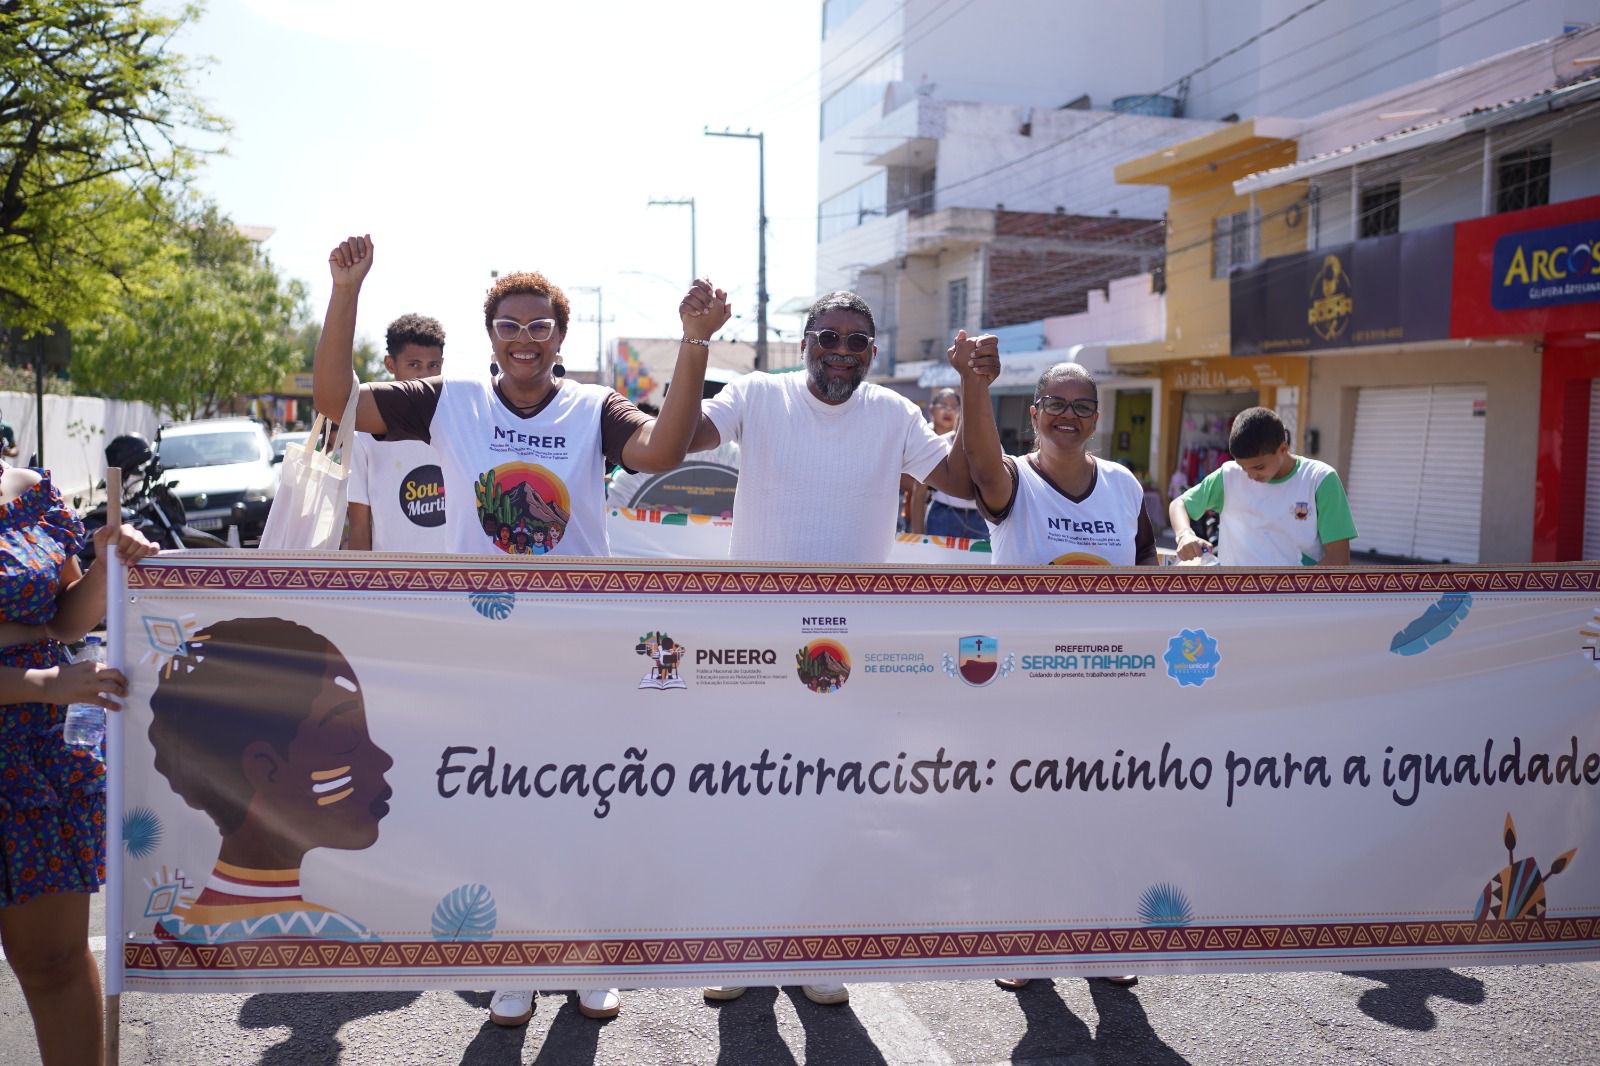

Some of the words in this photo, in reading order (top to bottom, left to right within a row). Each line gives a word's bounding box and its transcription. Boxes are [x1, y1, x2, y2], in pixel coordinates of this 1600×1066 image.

[494, 425, 566, 449] NTERER
[405, 480, 438, 501] Sou
[1047, 517, 1116, 534] NTERER
[802, 616, 847, 626] NTERER
[696, 649, 777, 665] PNEERQ
[1055, 645, 1110, 653] PREFEITURA
[1111, 645, 1124, 653] DE
[864, 653, 925, 662] SECRETARIA
[1021, 655, 1078, 670] SERRA
[1080, 654, 1156, 670] TALHADA
[864, 665, 877, 673] DE
[879, 662, 935, 675] EDUCAÇÃO
[436, 745, 676, 819] Educação
[688, 747, 996, 797] antirracista:
[1009, 742, 1213, 793] caminho
[1225, 750, 1331, 807] para
[1342, 753, 1370, 788] a
[1382, 735, 1600, 806] igualdade
